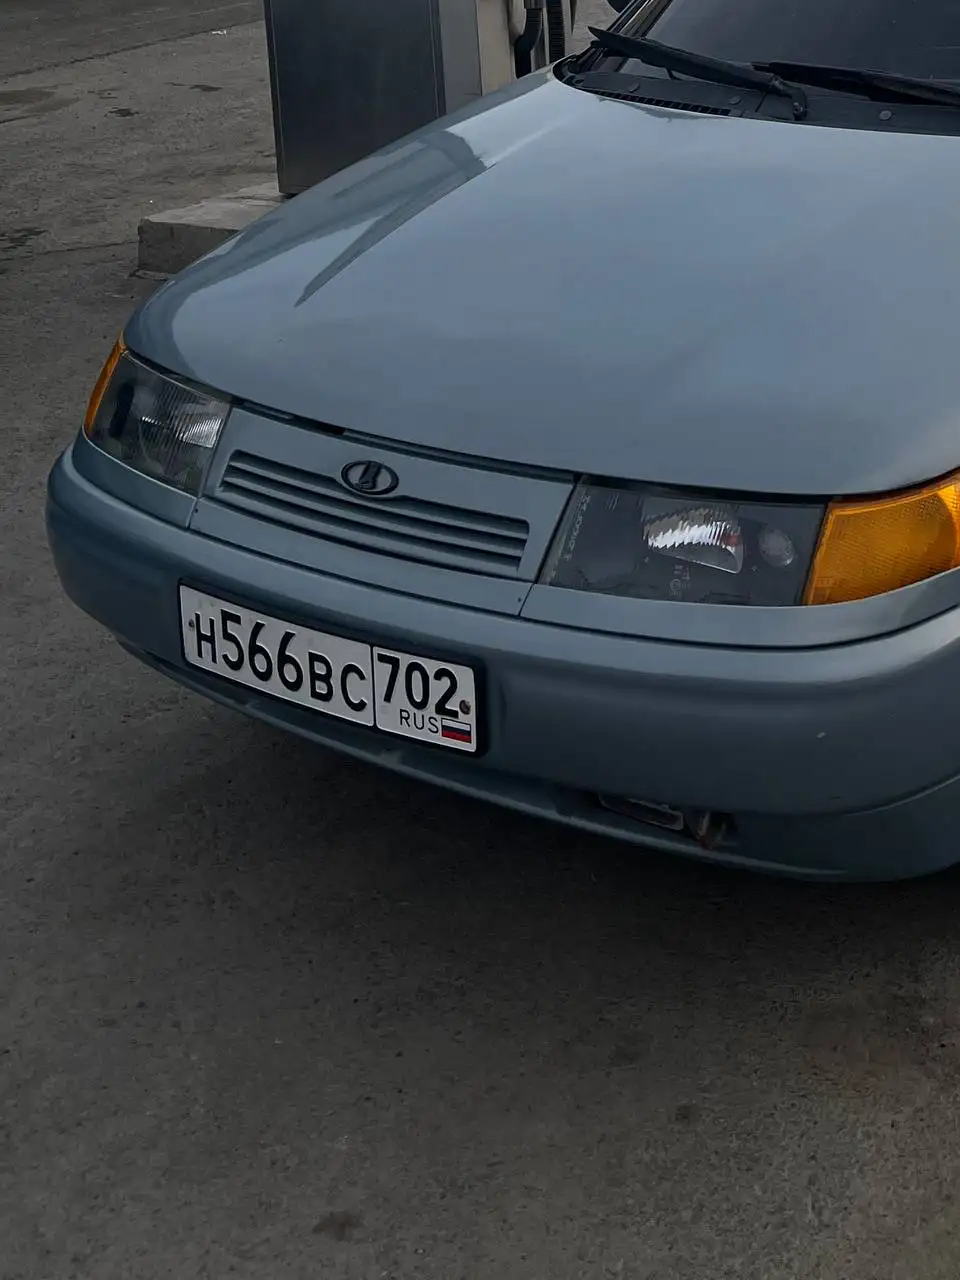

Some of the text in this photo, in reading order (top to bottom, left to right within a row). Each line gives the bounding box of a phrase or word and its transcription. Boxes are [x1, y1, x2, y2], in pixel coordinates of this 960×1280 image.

[194, 608, 460, 719] Н566ВС 702
[400, 708, 439, 734] RUS
